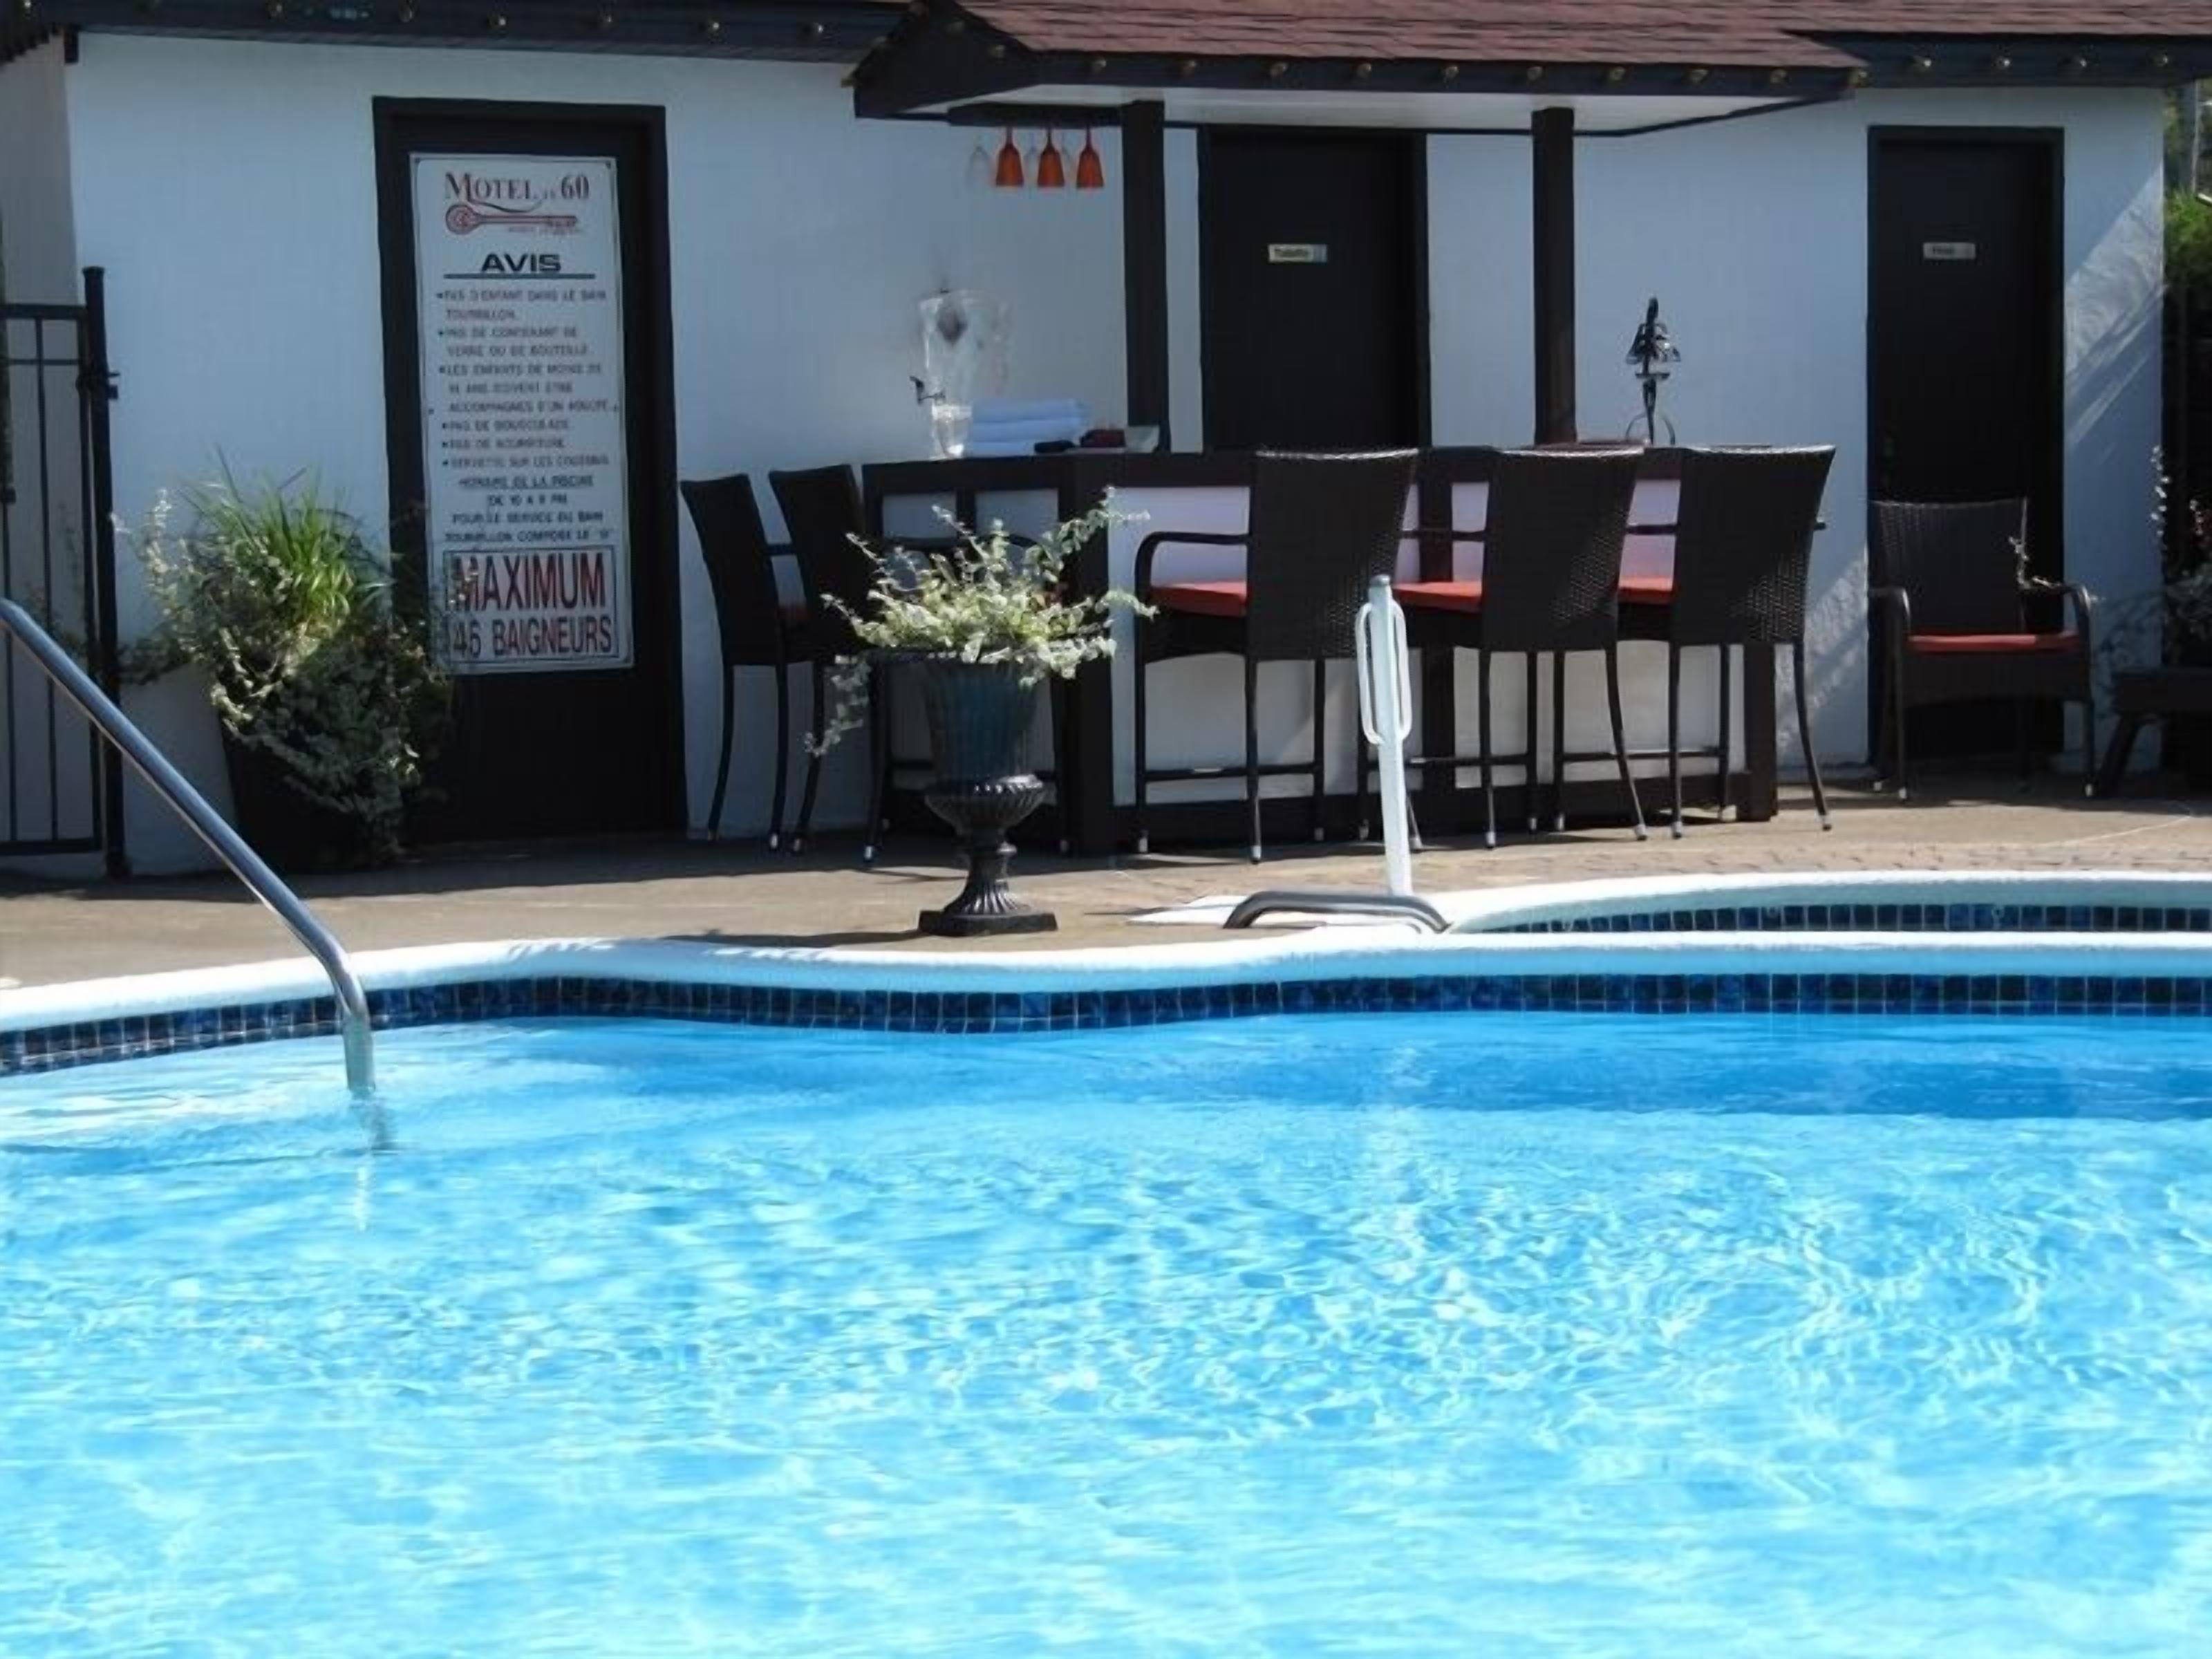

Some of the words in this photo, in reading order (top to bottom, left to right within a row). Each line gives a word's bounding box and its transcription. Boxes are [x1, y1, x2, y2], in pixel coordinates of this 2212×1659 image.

[561, 175, 590, 199] 60
[481, 253, 561, 272] AVIS
[444, 290, 465, 301] PAS
[528, 290, 558, 301] DANS
[563, 290, 574, 301] LE
[581, 290, 606, 301] BAIN
[472, 327, 486, 337] DE
[563, 326, 577, 337] DE
[447, 346, 483, 357] VERRE
[489, 346, 506, 357] OU
[510, 346, 526, 357] DE
[447, 364, 467, 375] LES
[473, 364, 522, 376] ENFANTS
[527, 364, 542, 375] DE
[547, 364, 583, 375] MOINS
[475, 420, 489, 430] DE
[475, 438, 490, 449] DE
[533, 456, 552, 467] LES
[487, 495, 503, 506] DE
[578, 511, 603, 522] BAIN
[453, 552, 606, 612] MAXIMUM
[492, 615, 612, 656] BAIGNEURS
